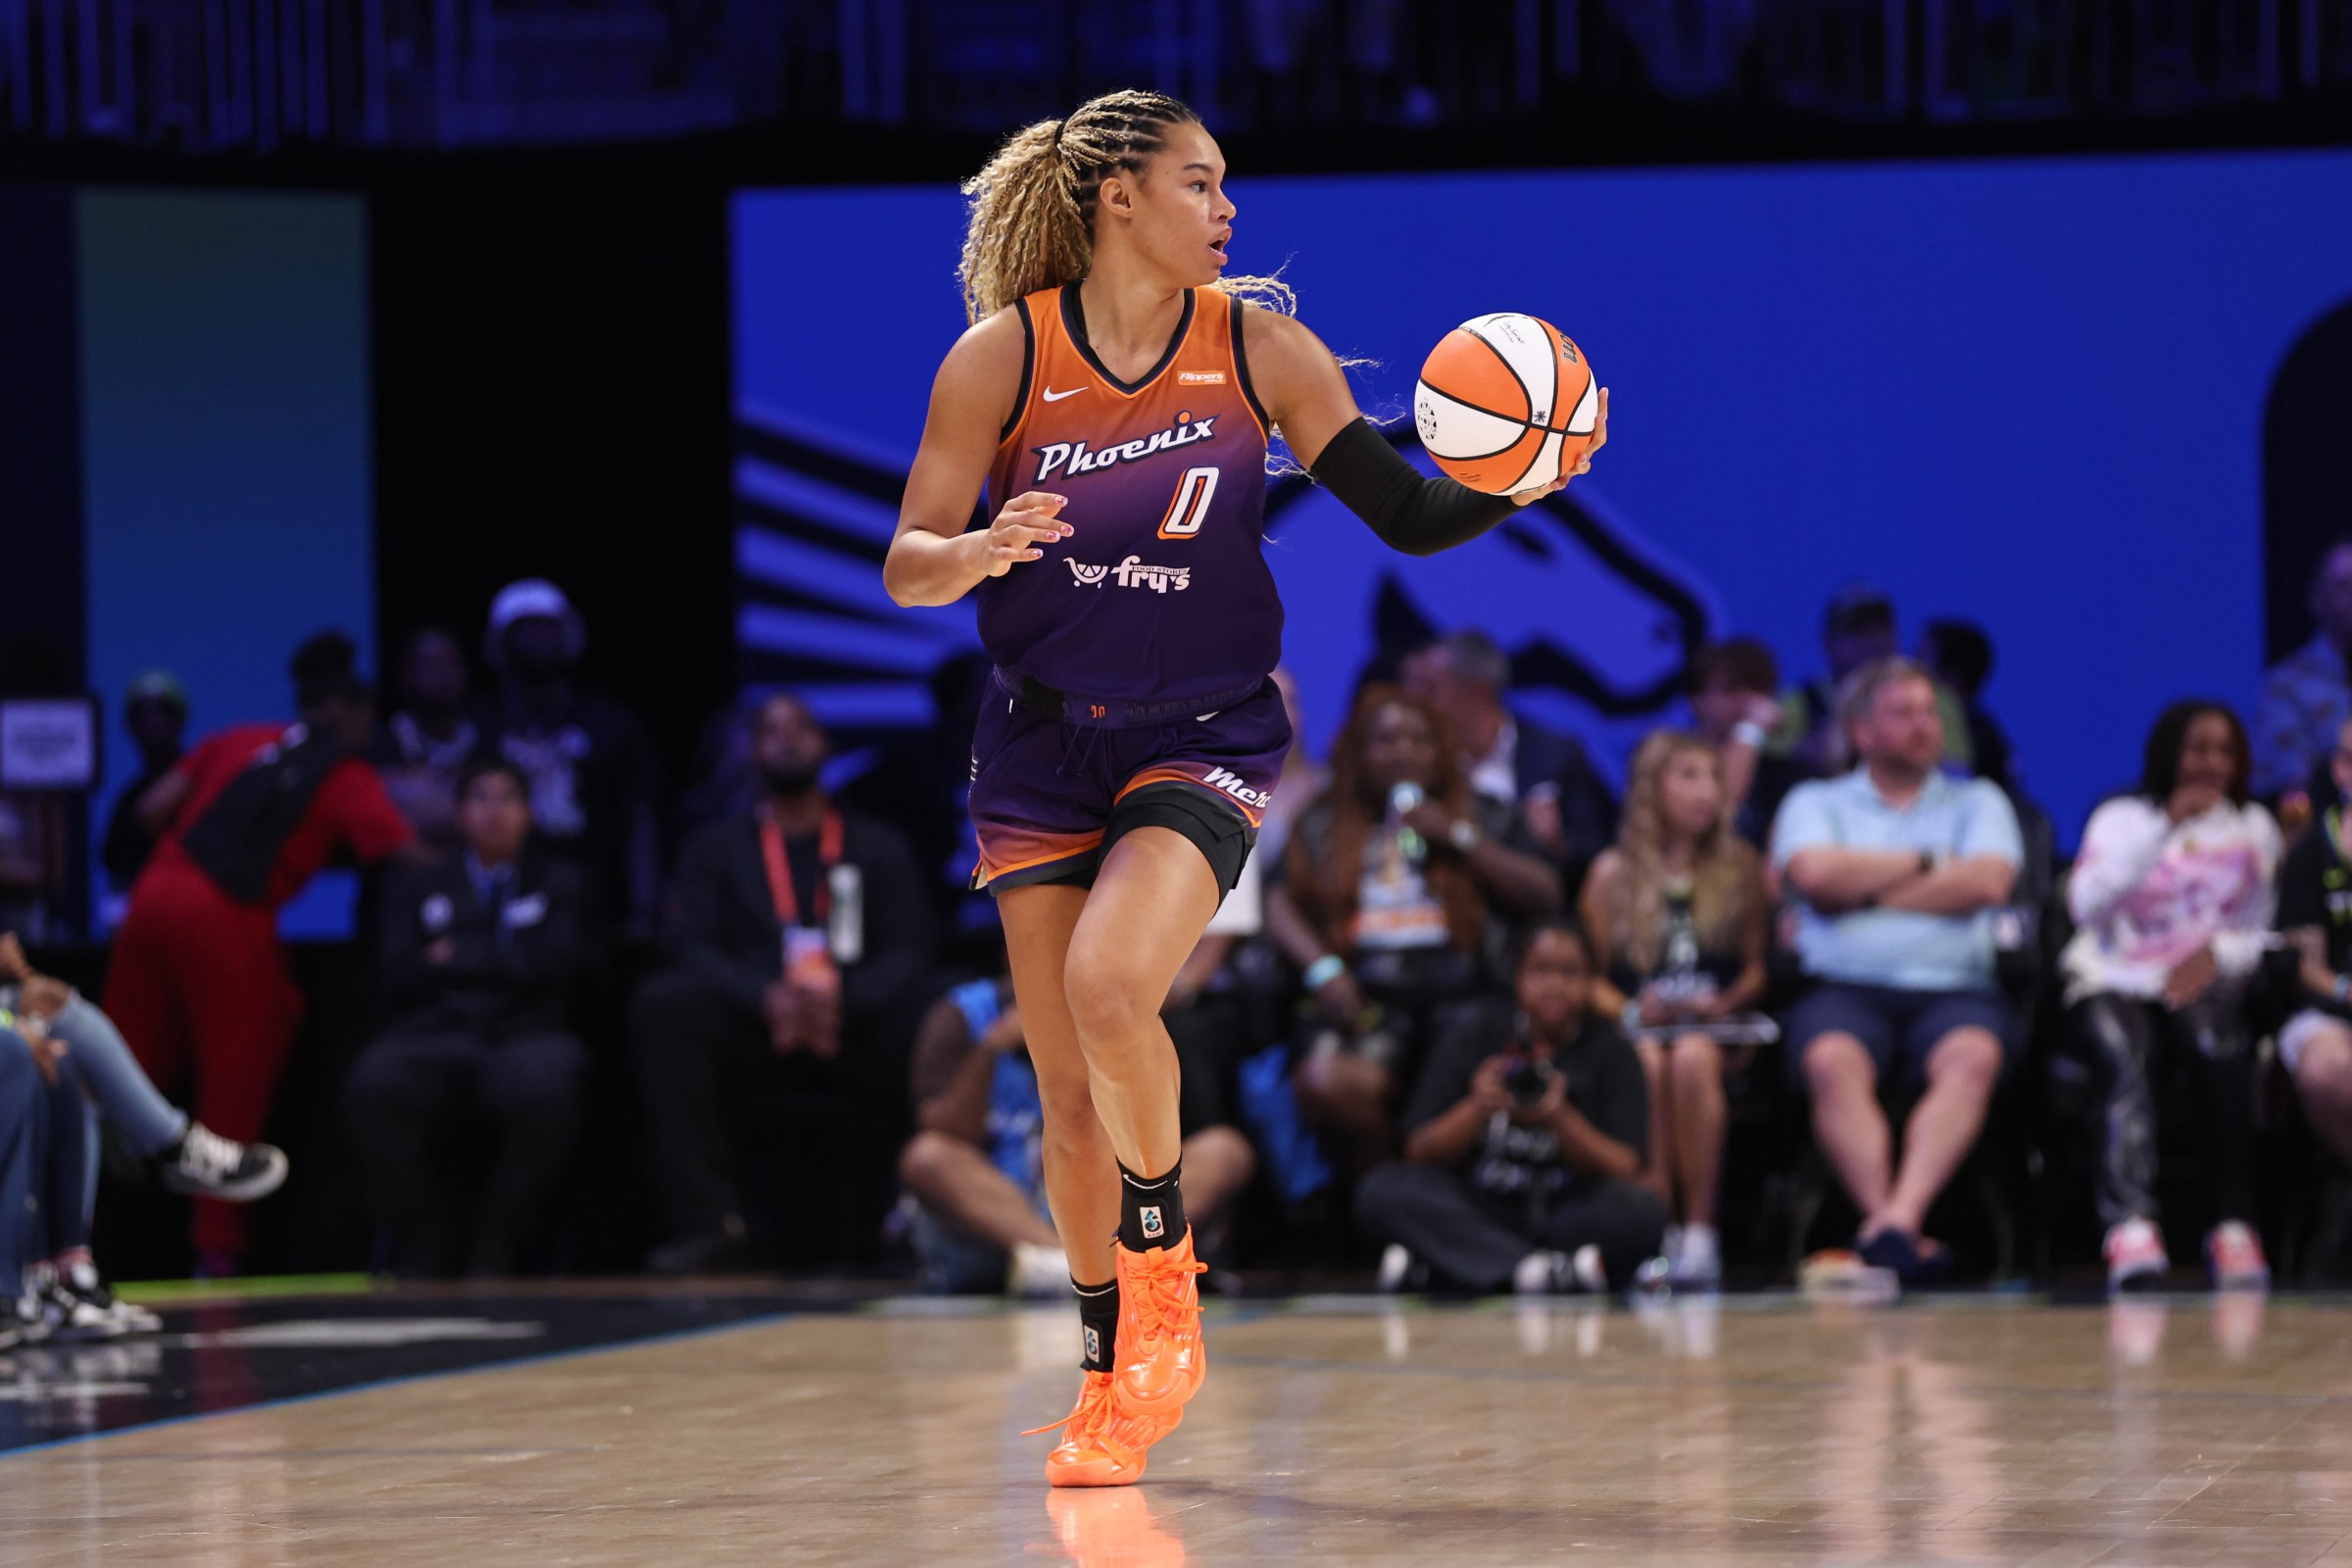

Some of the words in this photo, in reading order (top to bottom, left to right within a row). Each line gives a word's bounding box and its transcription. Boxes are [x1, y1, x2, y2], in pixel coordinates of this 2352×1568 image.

[1035, 410, 1217, 482] Phoenix
[1157, 466, 1220, 539] 0
[1110, 555, 1191, 594] fry's
